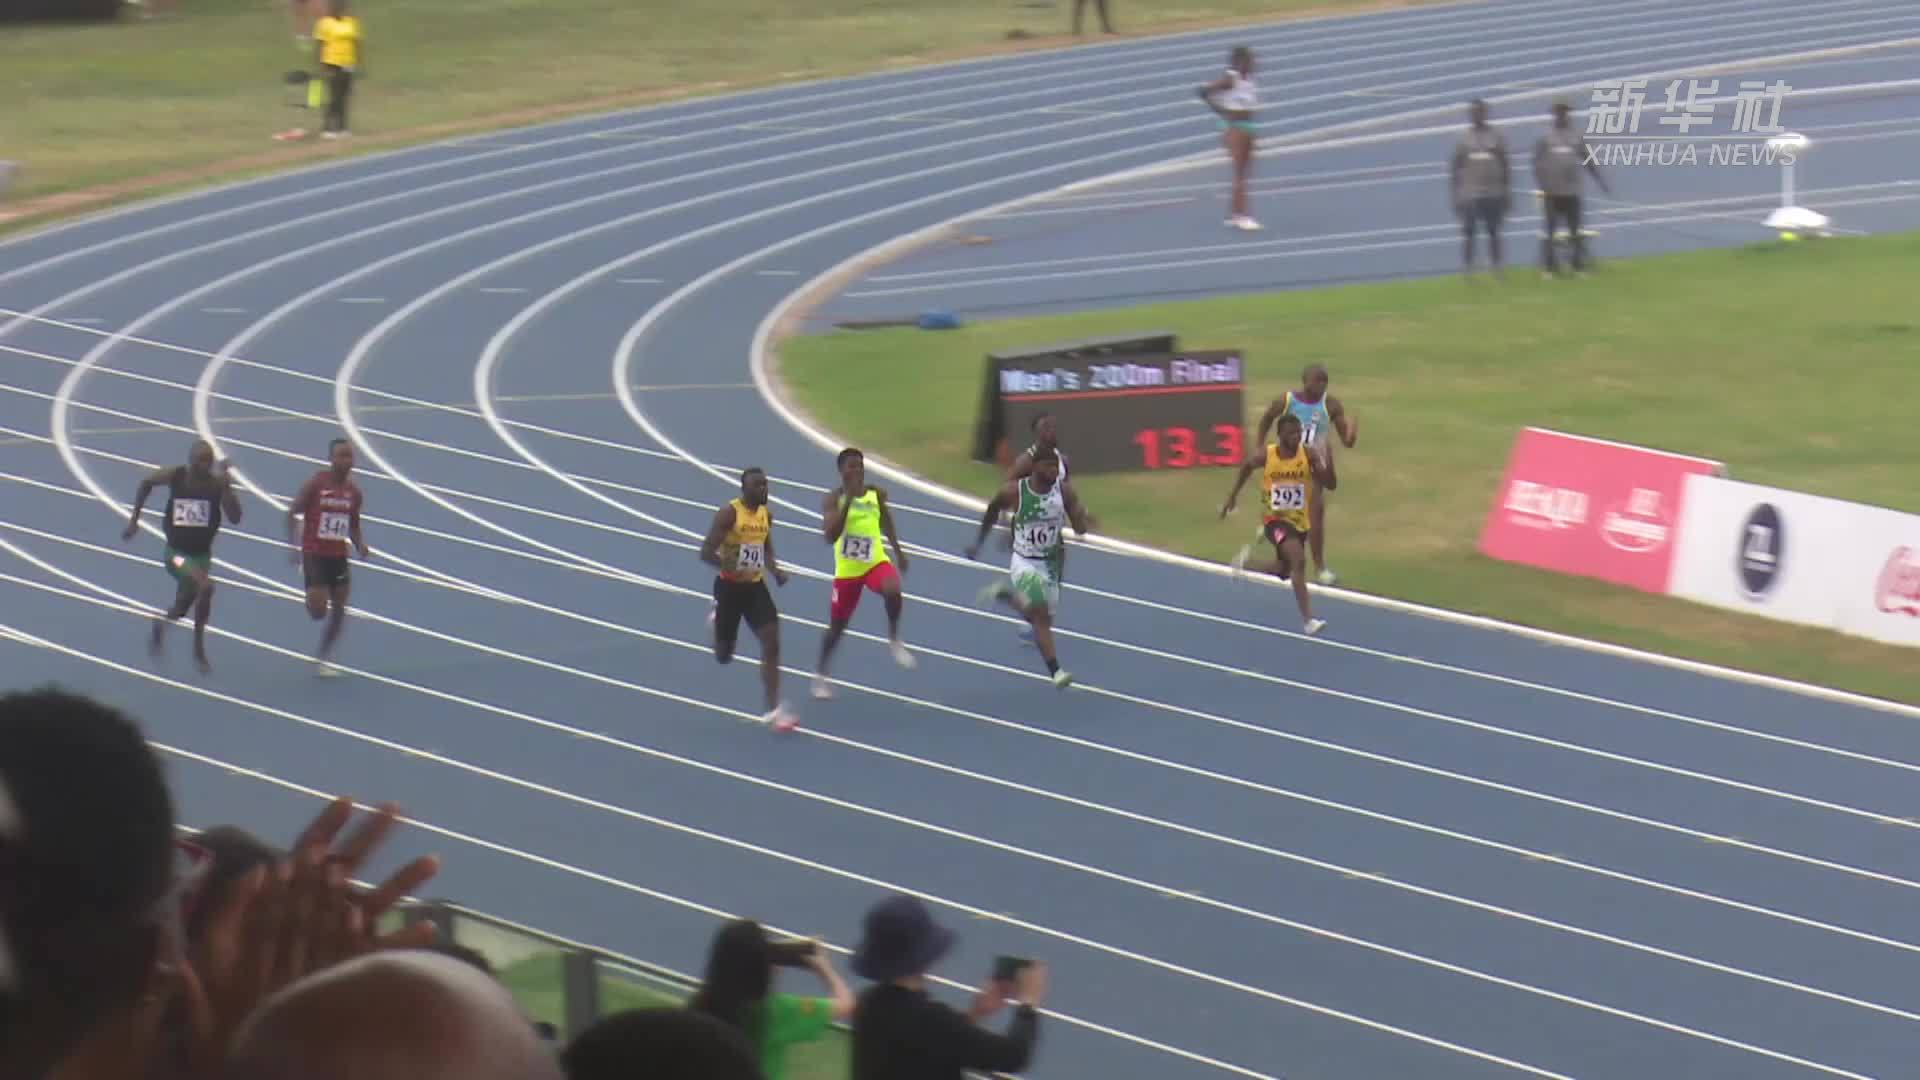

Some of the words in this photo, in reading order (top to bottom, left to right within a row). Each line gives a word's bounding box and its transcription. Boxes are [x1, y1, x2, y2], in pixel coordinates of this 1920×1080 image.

[1170, 356, 1240, 385] Final
[1134, 423, 1243, 468] 13.3
[1273, 489, 1302, 506] 292
[1027, 526, 1056, 545] 467
[741, 549, 764, 568] 29
[843, 538, 871, 559] 124
